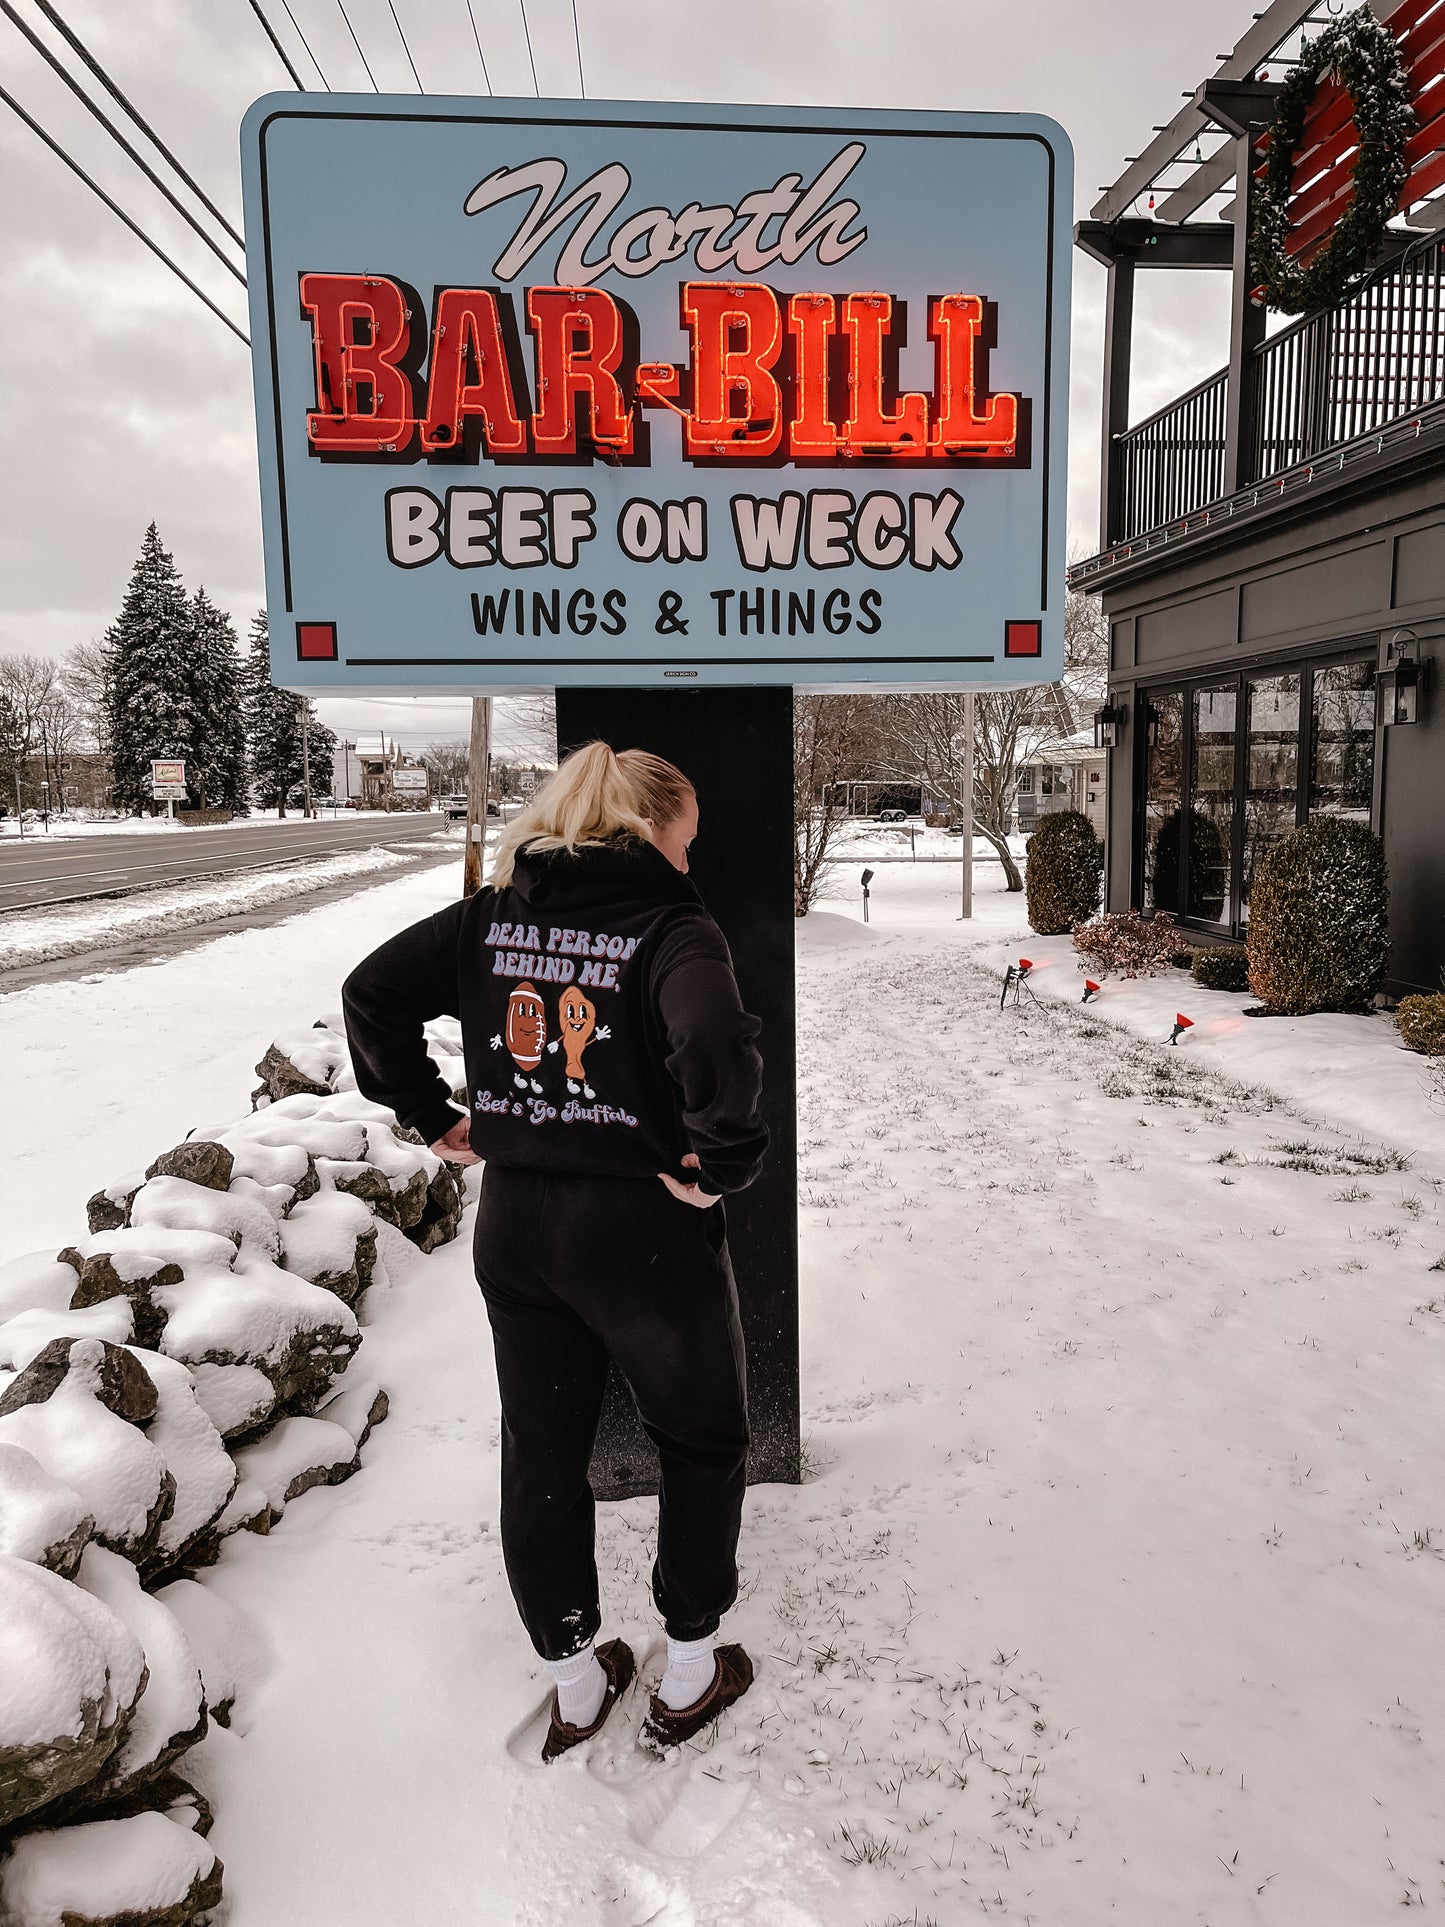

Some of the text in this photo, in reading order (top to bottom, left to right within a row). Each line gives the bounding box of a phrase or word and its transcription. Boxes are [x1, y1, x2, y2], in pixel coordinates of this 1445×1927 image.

[463, 141, 868, 287] North
[298, 271, 1032, 470] BAR-BILL
[384, 487, 964, 571] BEEF ON WECK
[470, 588, 884, 637] WINGS & THINGS
[485, 922, 643, 961] DEAR PERSON
[492, 951, 621, 992] BEHIND ME,
[475, 1090, 640, 1128] Let's Go Buffalo
